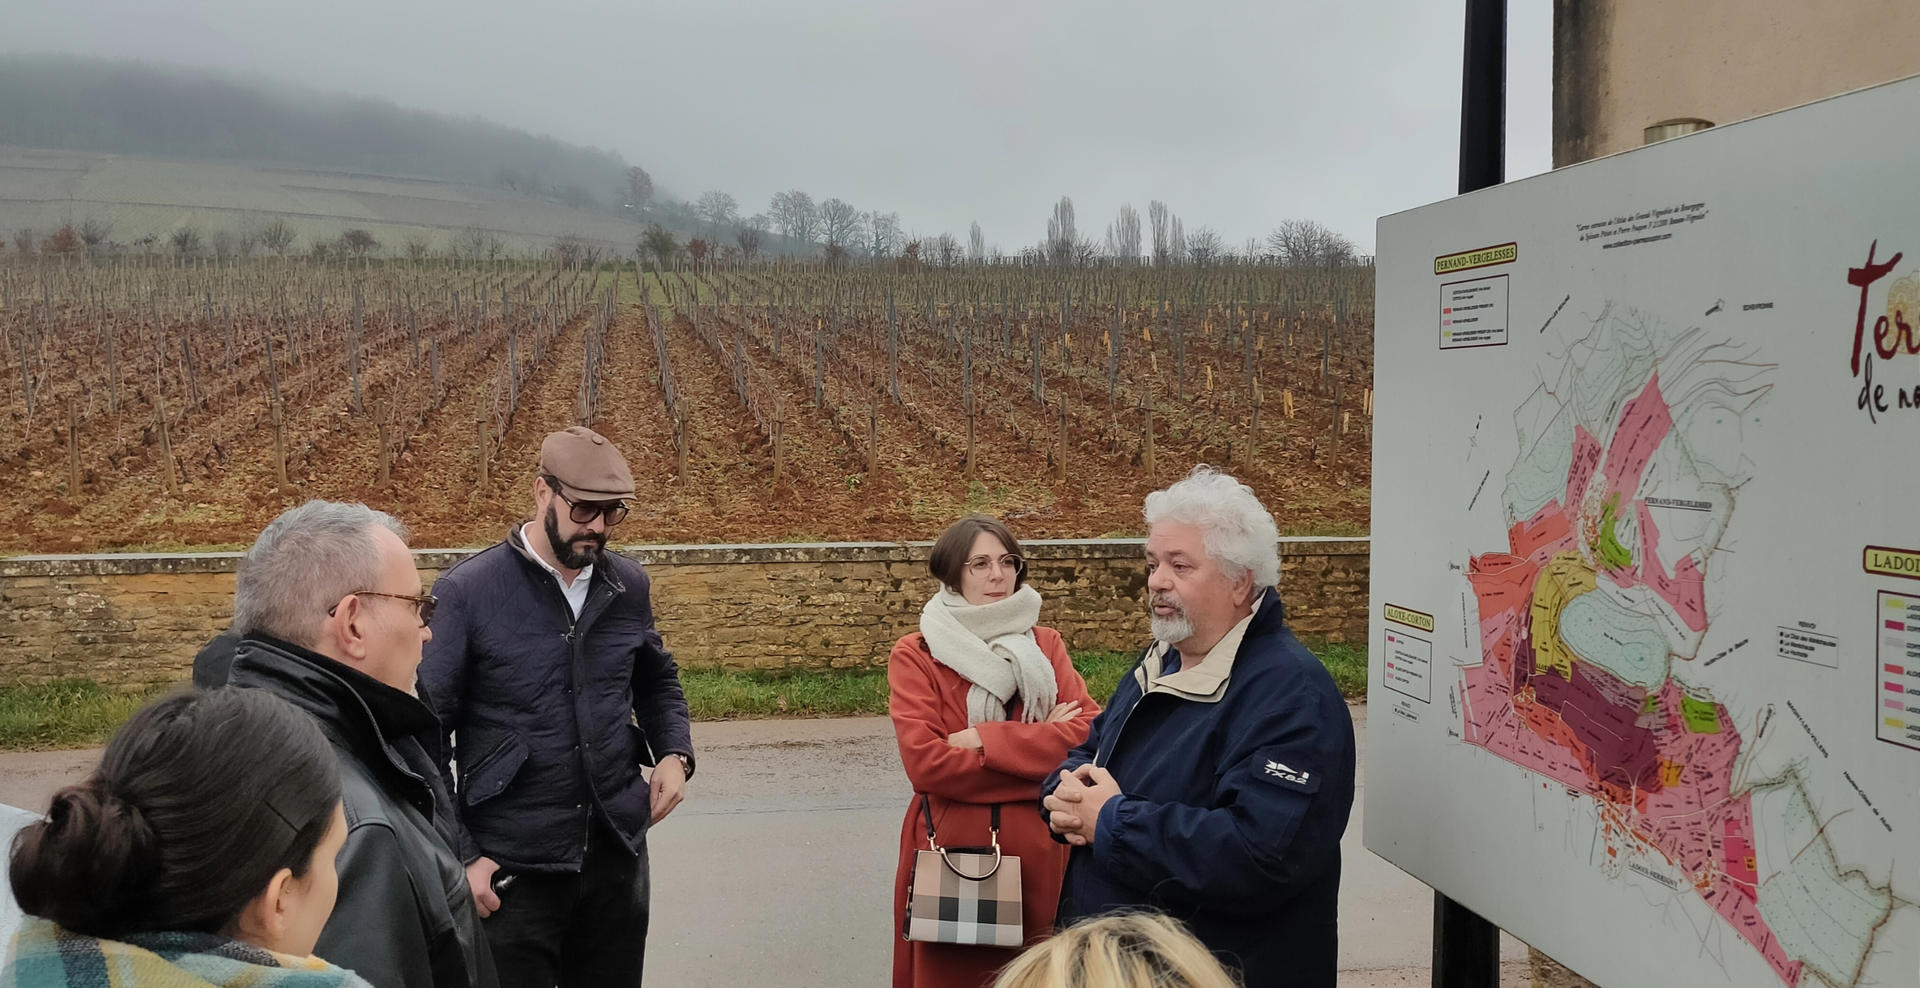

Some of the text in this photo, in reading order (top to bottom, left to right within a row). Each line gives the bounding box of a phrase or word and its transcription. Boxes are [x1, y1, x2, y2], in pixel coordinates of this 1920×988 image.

[1437, 247, 1515, 271] PERNAND-VERGELESSES
[1848, 239, 1920, 377] Ter
[1858, 353, 1888, 424] de
[1387, 608, 1431, 627] ALOXE-CORTON
